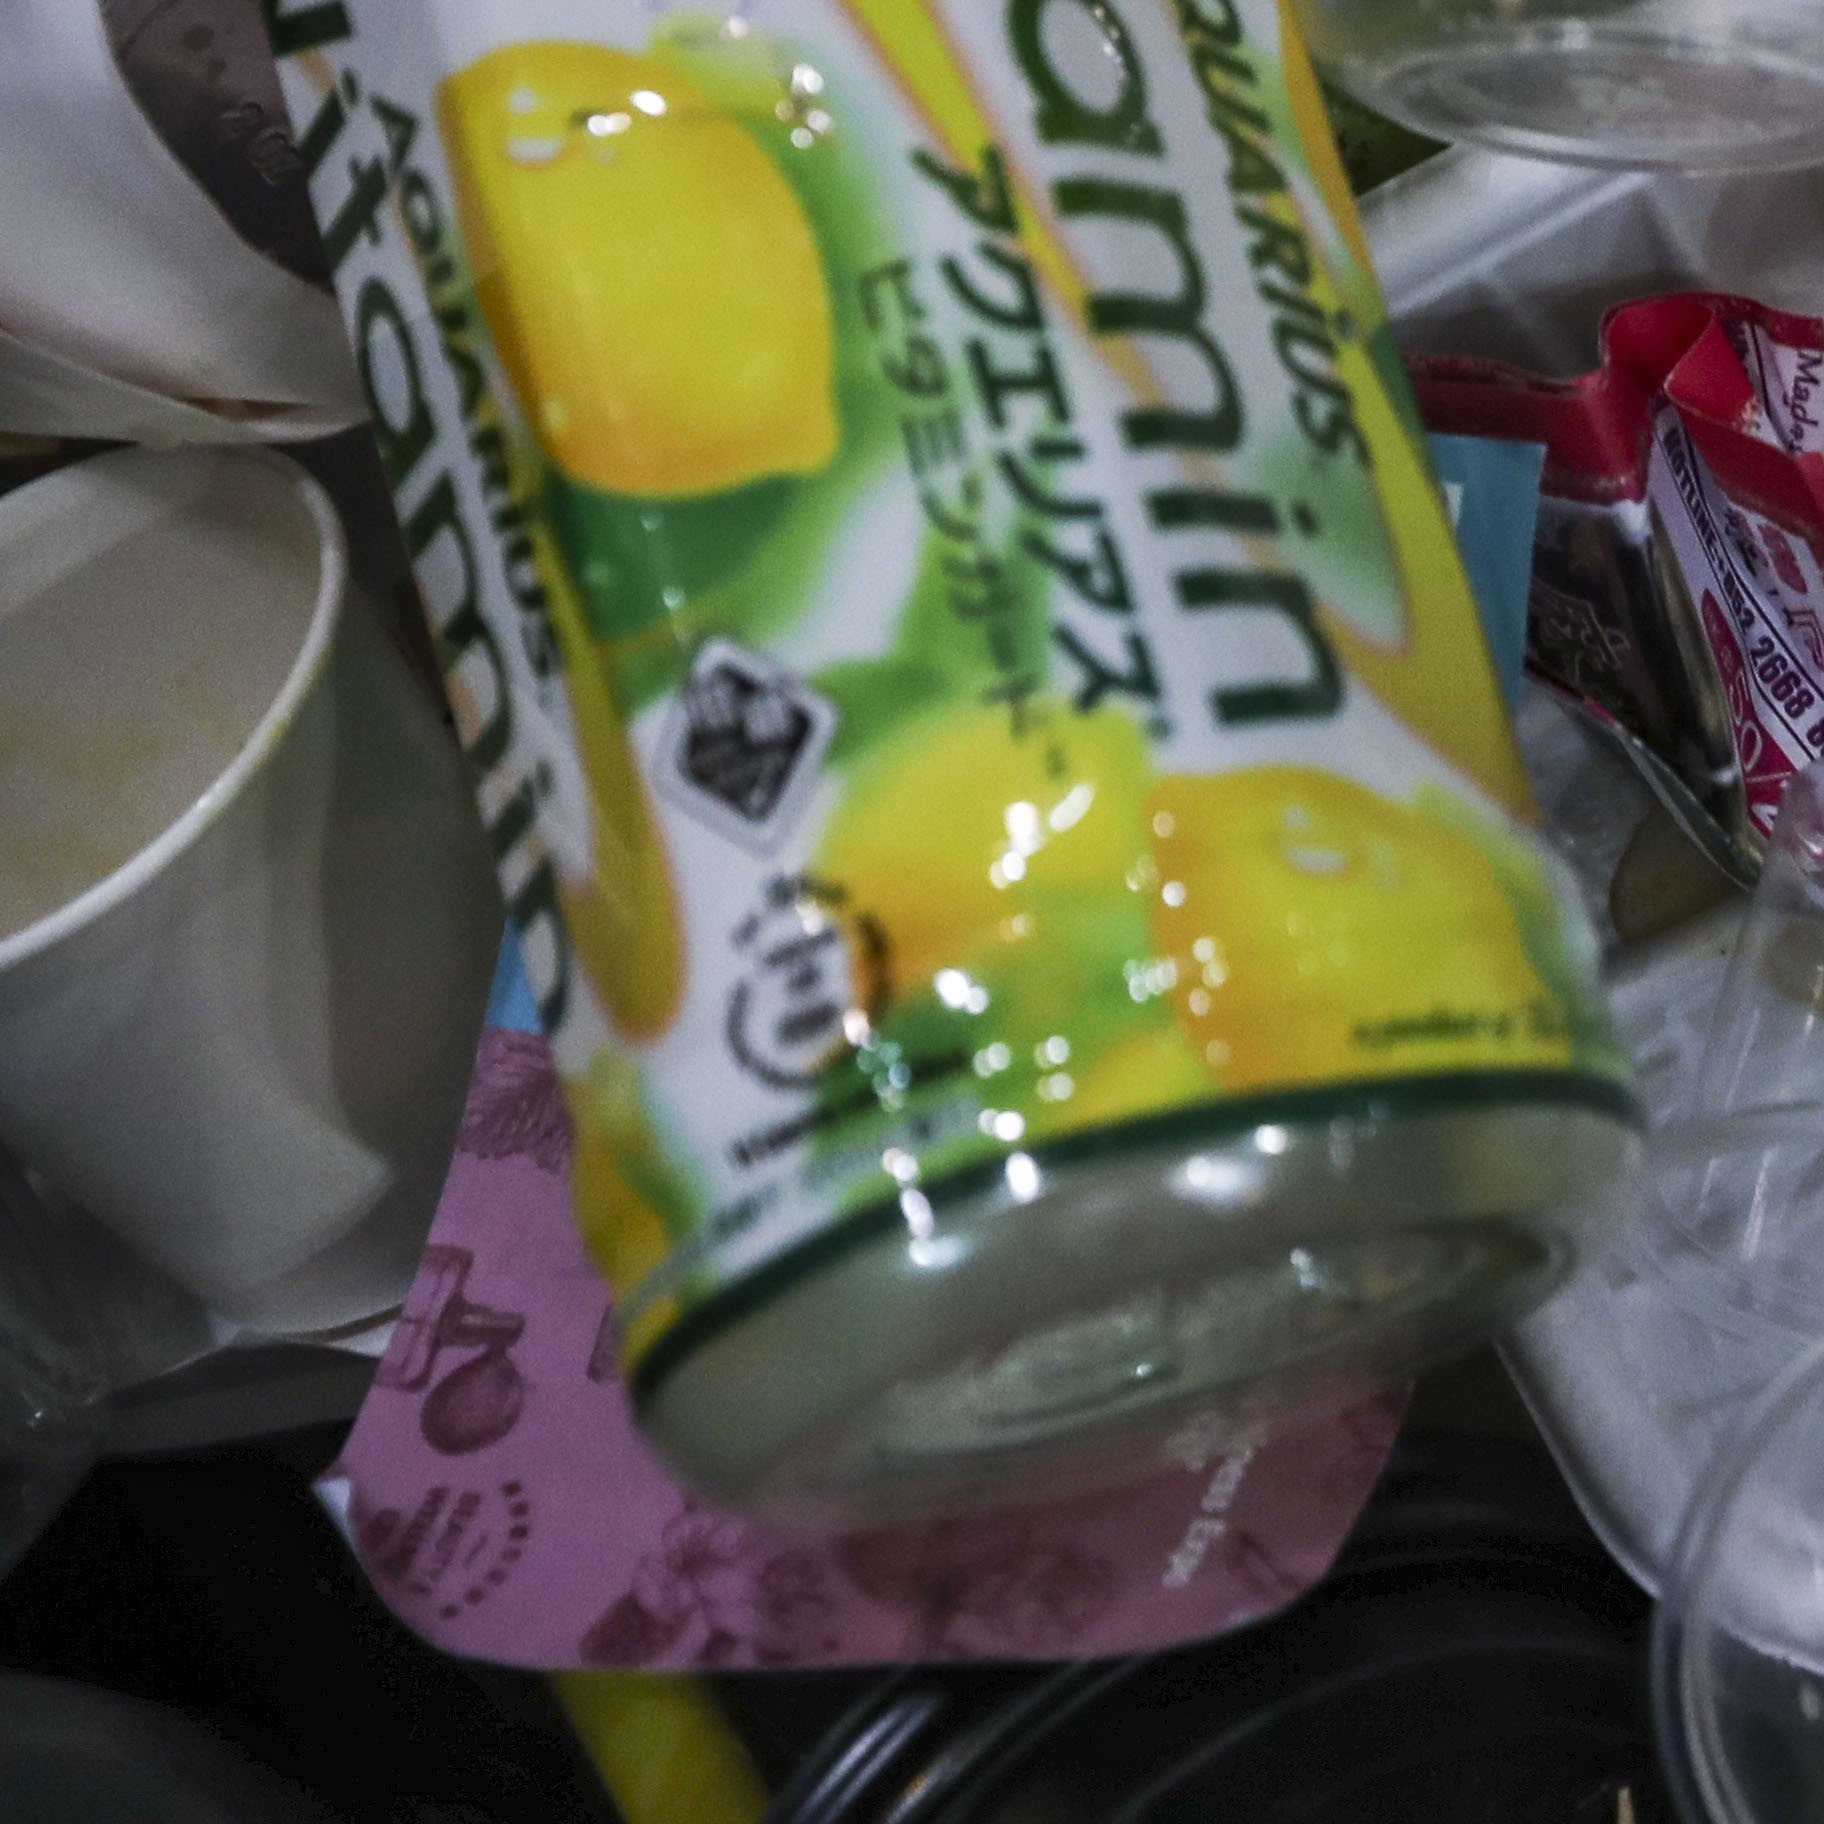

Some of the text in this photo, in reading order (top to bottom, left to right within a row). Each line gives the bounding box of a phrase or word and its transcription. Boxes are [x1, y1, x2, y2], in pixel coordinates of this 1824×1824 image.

[912, 138, 1162, 714] アクエリアス
[1749, 635, 1816, 722] 2668
